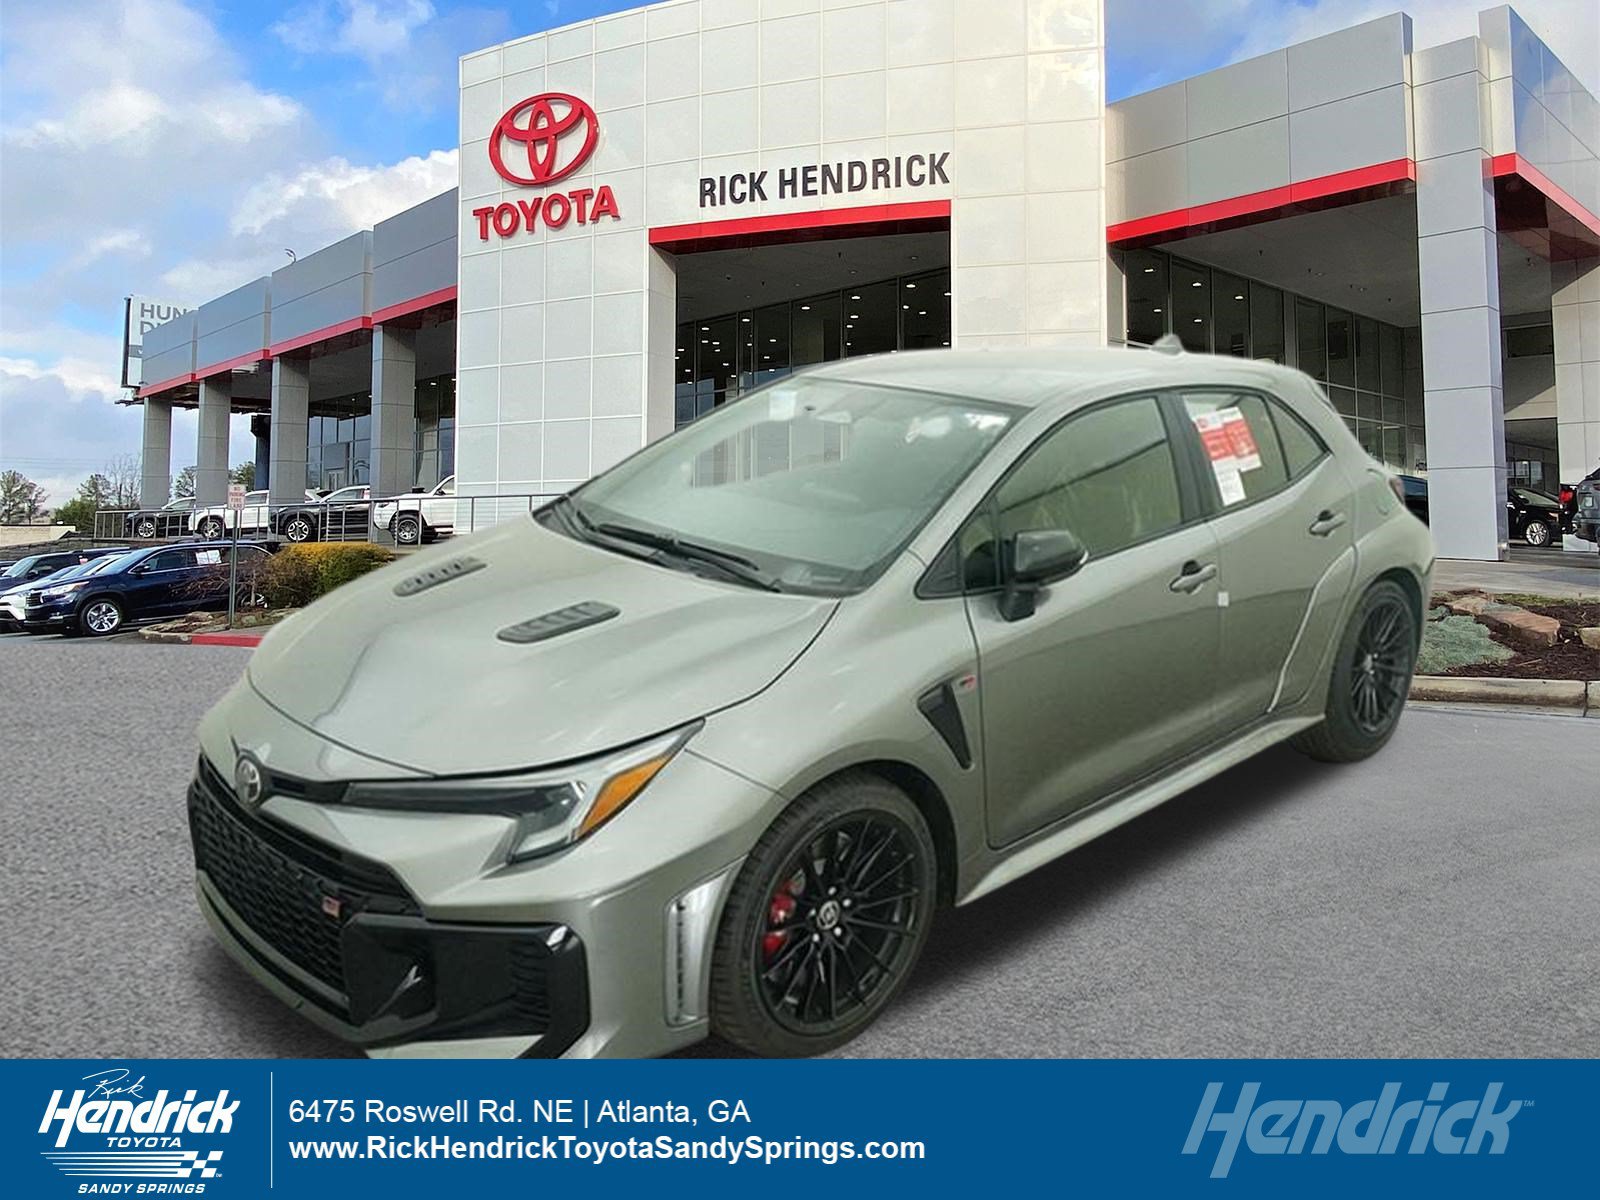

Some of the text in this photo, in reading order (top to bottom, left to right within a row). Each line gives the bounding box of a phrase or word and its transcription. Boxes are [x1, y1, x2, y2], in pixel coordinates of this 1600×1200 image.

[699, 152, 951, 208] RICK HENDRICK
[473, 185, 620, 240] TOYOTA
